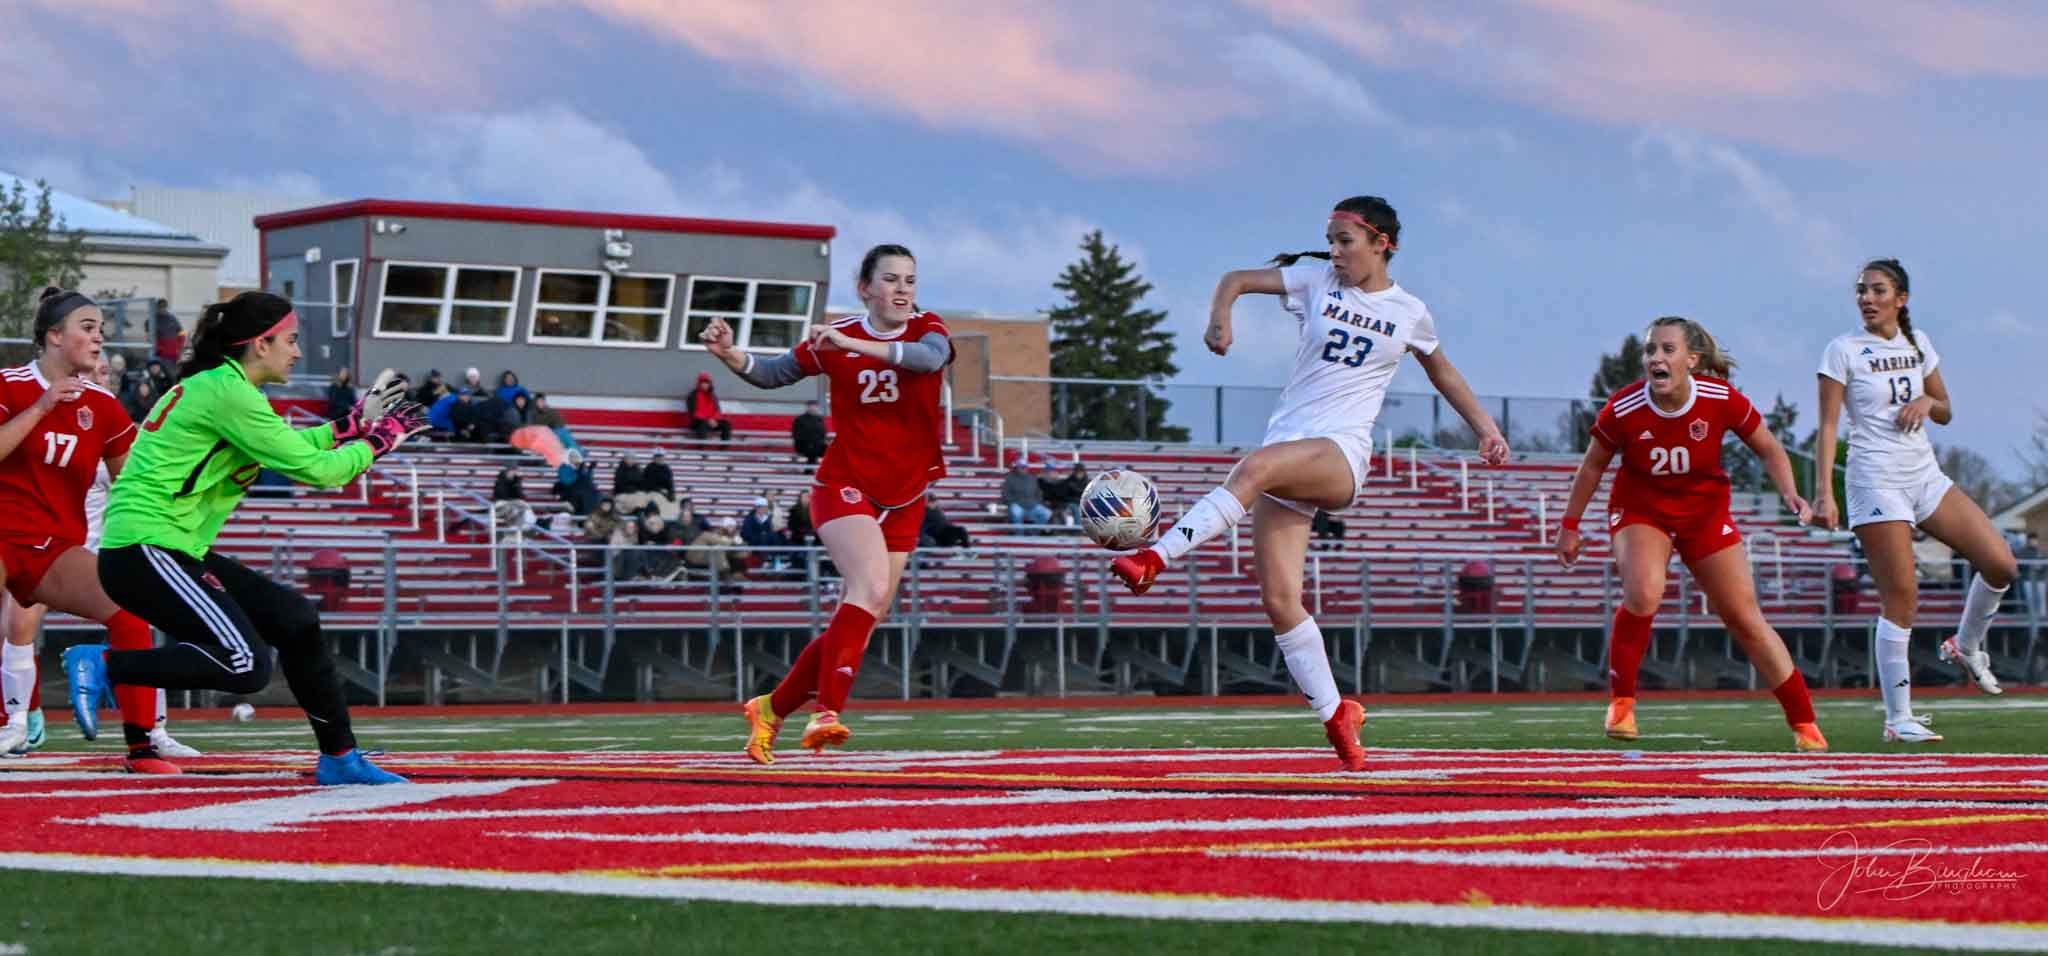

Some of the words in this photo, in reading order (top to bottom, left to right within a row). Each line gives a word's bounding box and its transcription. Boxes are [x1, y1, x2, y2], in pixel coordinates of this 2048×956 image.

[1322, 303, 1397, 338] MARIAN
[1321, 328, 1374, 368] 23
[857, 369, 899, 404] 23
[1888, 376, 1912, 404] 13
[44, 431, 78, 467] 17
[1649, 446, 1690, 475] 20
